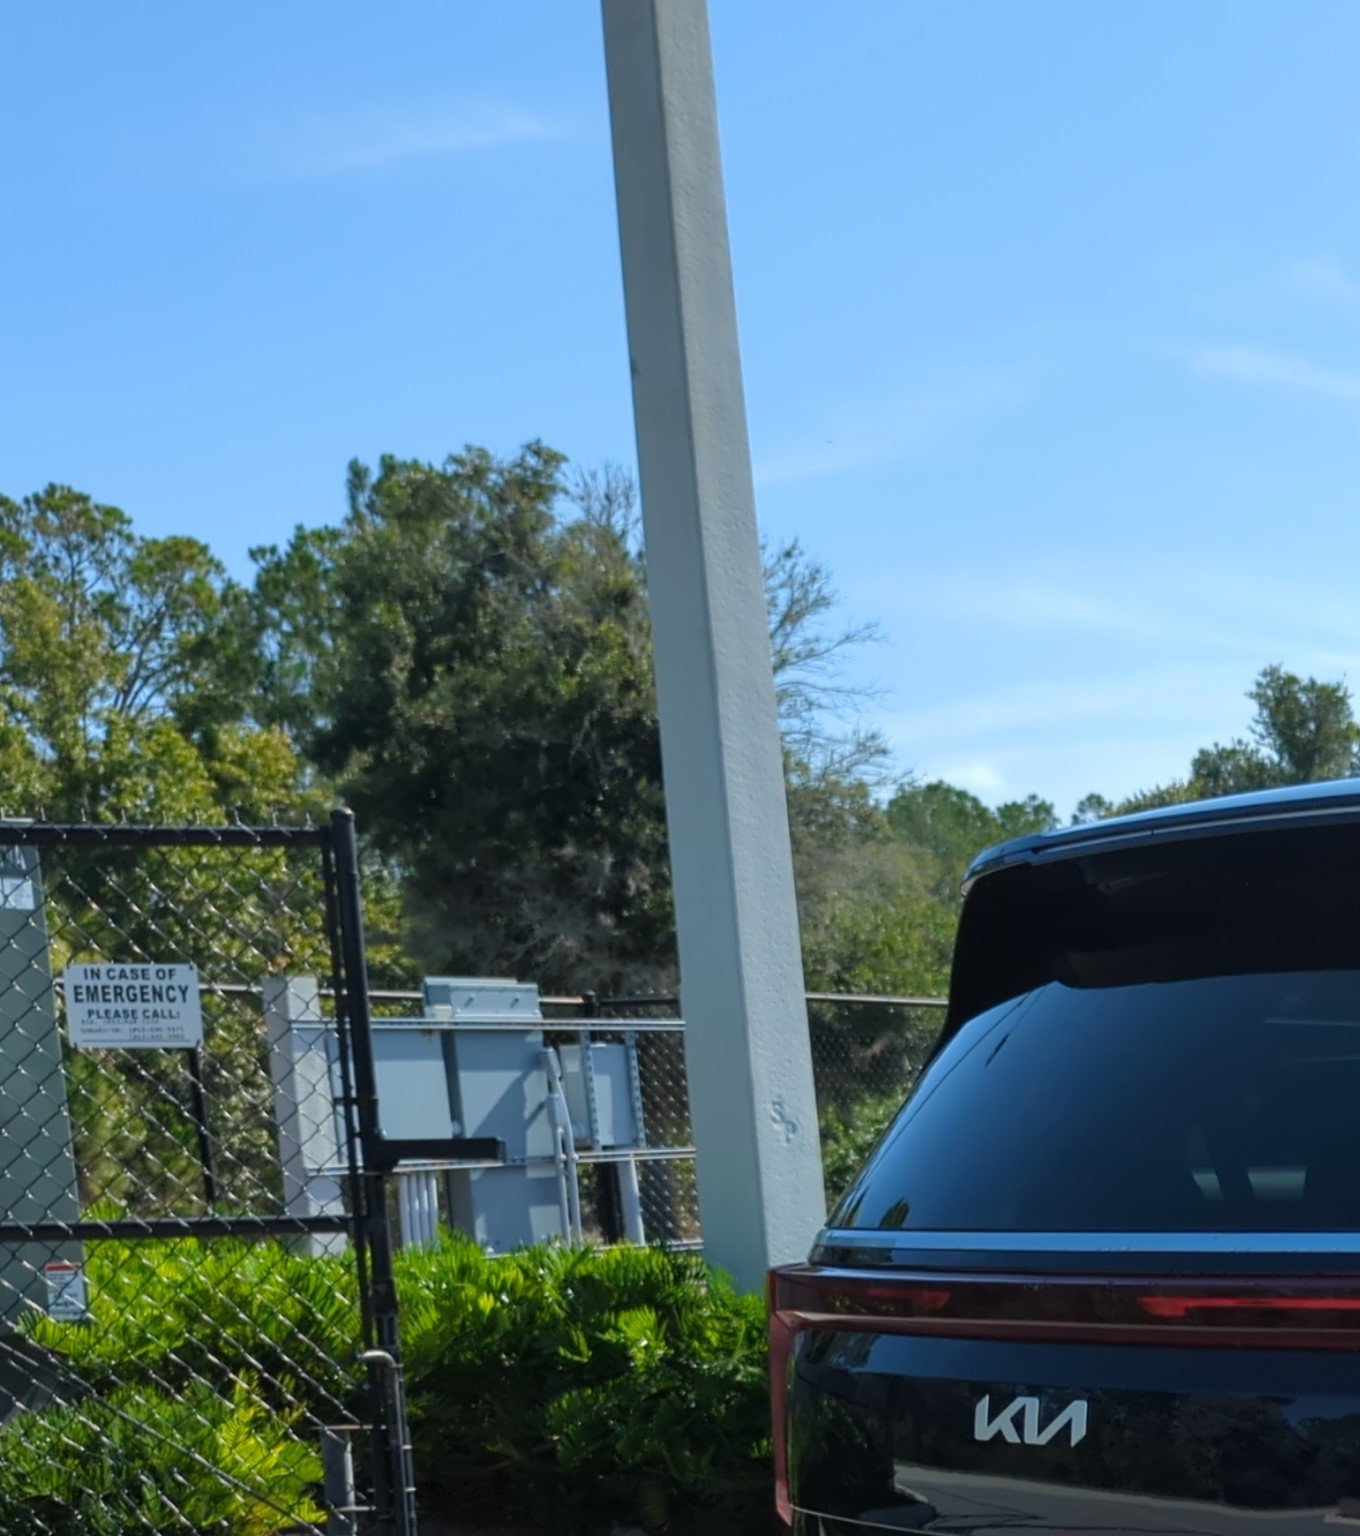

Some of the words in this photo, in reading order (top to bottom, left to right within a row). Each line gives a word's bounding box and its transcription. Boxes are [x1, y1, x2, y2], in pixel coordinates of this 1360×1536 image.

[83, 968, 100, 981] IN
[106, 968, 151, 981] CASE
[156, 968, 177, 981] OF
[73, 985, 189, 1003] EMERGENCY
[87, 1009, 139, 1019] PLEASE
[142, 1009, 181, 1020] CALL:
[974, 1394, 1088, 1448] KIA
